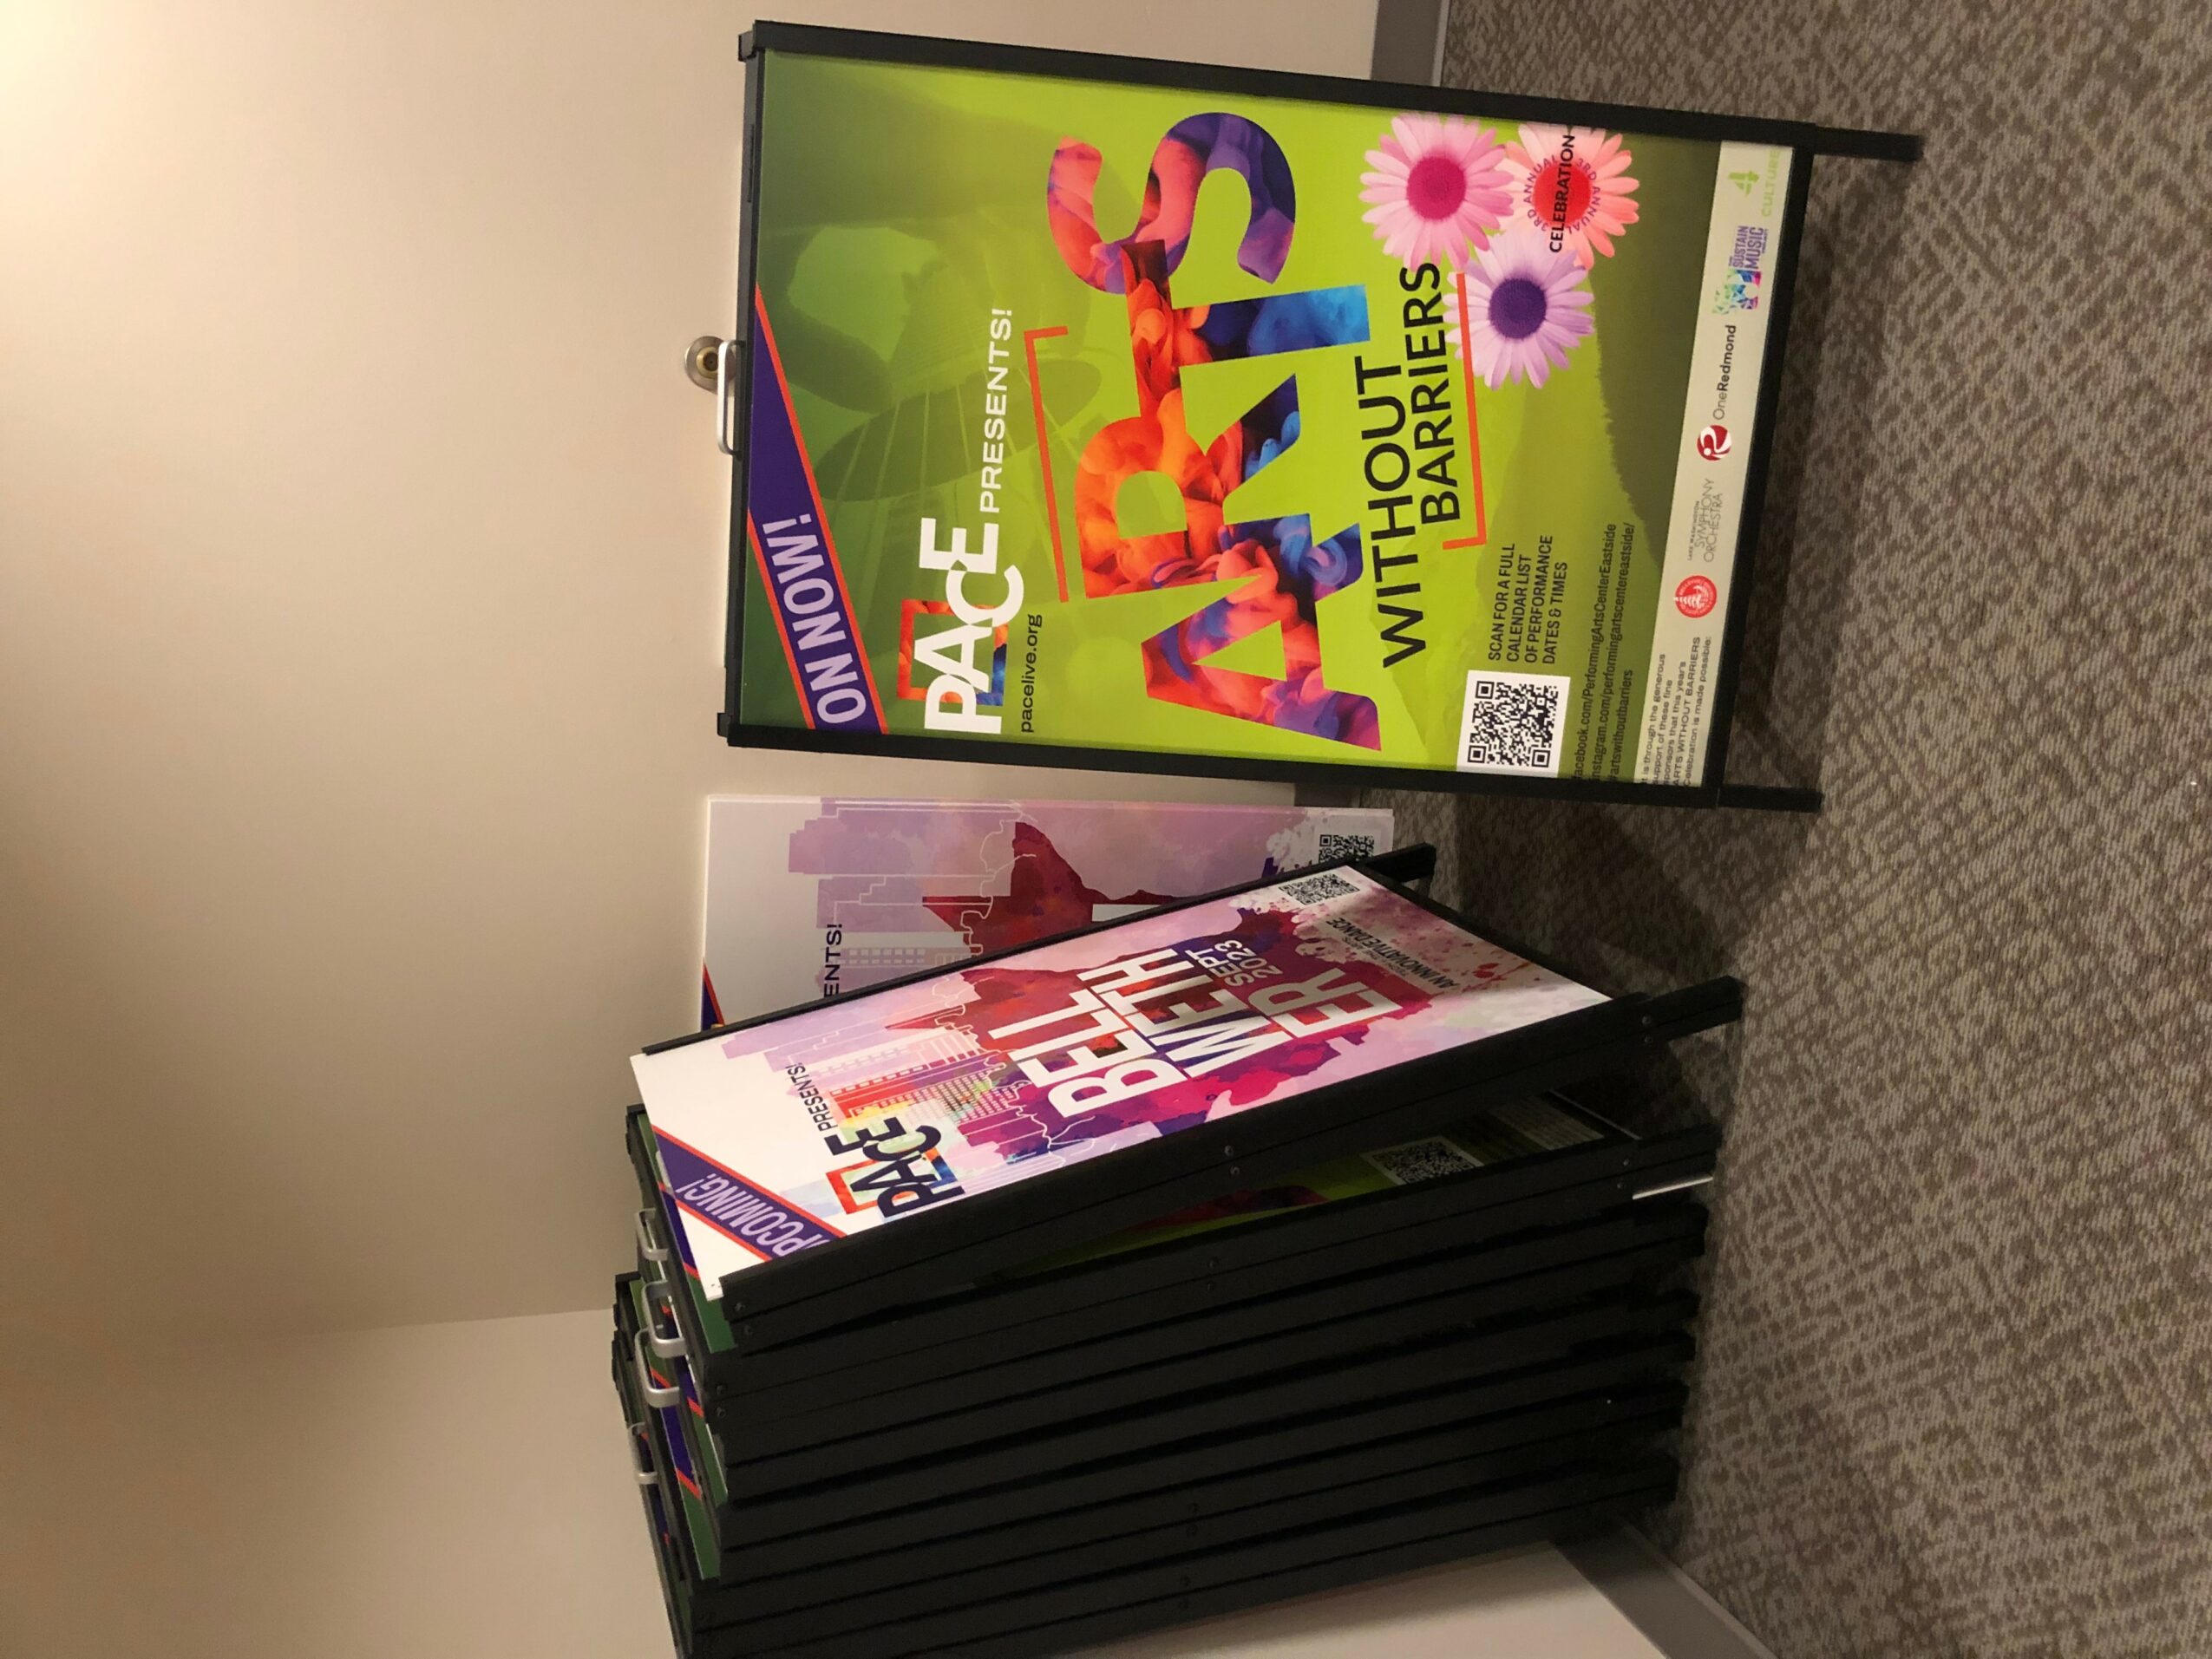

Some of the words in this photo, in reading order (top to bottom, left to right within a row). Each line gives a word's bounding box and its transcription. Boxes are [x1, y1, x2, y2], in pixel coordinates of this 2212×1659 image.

[1522, 154, 1558, 204] ANNUAL
[1576, 158, 1597, 180] 3RD
[1760, 149, 1778, 217] CULTURE
[1549, 135, 1575, 253] CELEBRATION
[1567, 186, 1600, 234] ANNUAL
[1527, 209, 1548, 232] 3RD
[1732, 225, 1749, 268] SUSTAIN
[1744, 227, 1764, 269] MUSIC
[1399, 263, 1460, 524] BARRIERS
[1712, 324, 1736, 420] OneRedmond
[1047, 112, 1382, 751] ARTS
[913, 517, 1024, 735] PACE
[978, 308, 1012, 513] PRESENTS!
[1354, 356, 1426, 669] WITHOUT
[1693, 478, 1714, 549] SYMPHONY
[1703, 493, 1724, 563] ORCHESTRA
[762, 513, 847, 650] NOW!
[1498, 543, 1515, 577] FULL
[1516, 554, 1532, 585] LIST
[1550, 562, 1568, 605] TIMES
[1493, 592, 1509, 620] FOR
[1497, 580, 1510, 590] A
[1527, 535, 1553, 643] PERFORMANCE
[1507, 587, 1528, 663] CALENDAR
[1548, 608, 1561, 618] &
[1488, 623, 1505, 661] SCAN
[1524, 645, 1538, 663] OF
[1542, 620, 1561, 664] DATES
[808, 653, 867, 723] ON
[1019, 613, 1042, 733] pacelive.org
[1652, 654, 1666, 702] generous
[1663, 680, 1672, 698] fine
[1675, 661, 1686, 692] year's
[1684, 637, 1700, 696] BARRIERS
[1649, 705, 1659, 722] the
[1659, 702, 1670, 730] these
[1669, 716, 1679, 736] that
[1672, 695, 1681, 713] this
[1677, 699, 1691, 753] WITHOUT
[1643, 724, 1656, 763] through
[1657, 733, 1665, 743] of
[1683, 728, 1698, 787] Celebration
[1695, 685, 1705, 715] made
[1672, 756, 1683, 785] ARTS
[1325, 917, 1375, 941] DANCE
[823, 924, 842, 998] ENTS!
[1185, 948, 1255, 986] SEPT
[1214, 939, 1283, 978] 2023
[1077, 948, 1293, 1078] WETH
[1247, 968, 1404, 1038] ER
[987, 988, 1188, 1118] BELL
[785, 1061, 838, 1132] PRESENTS!
[823, 1117, 965, 1218] PACE
